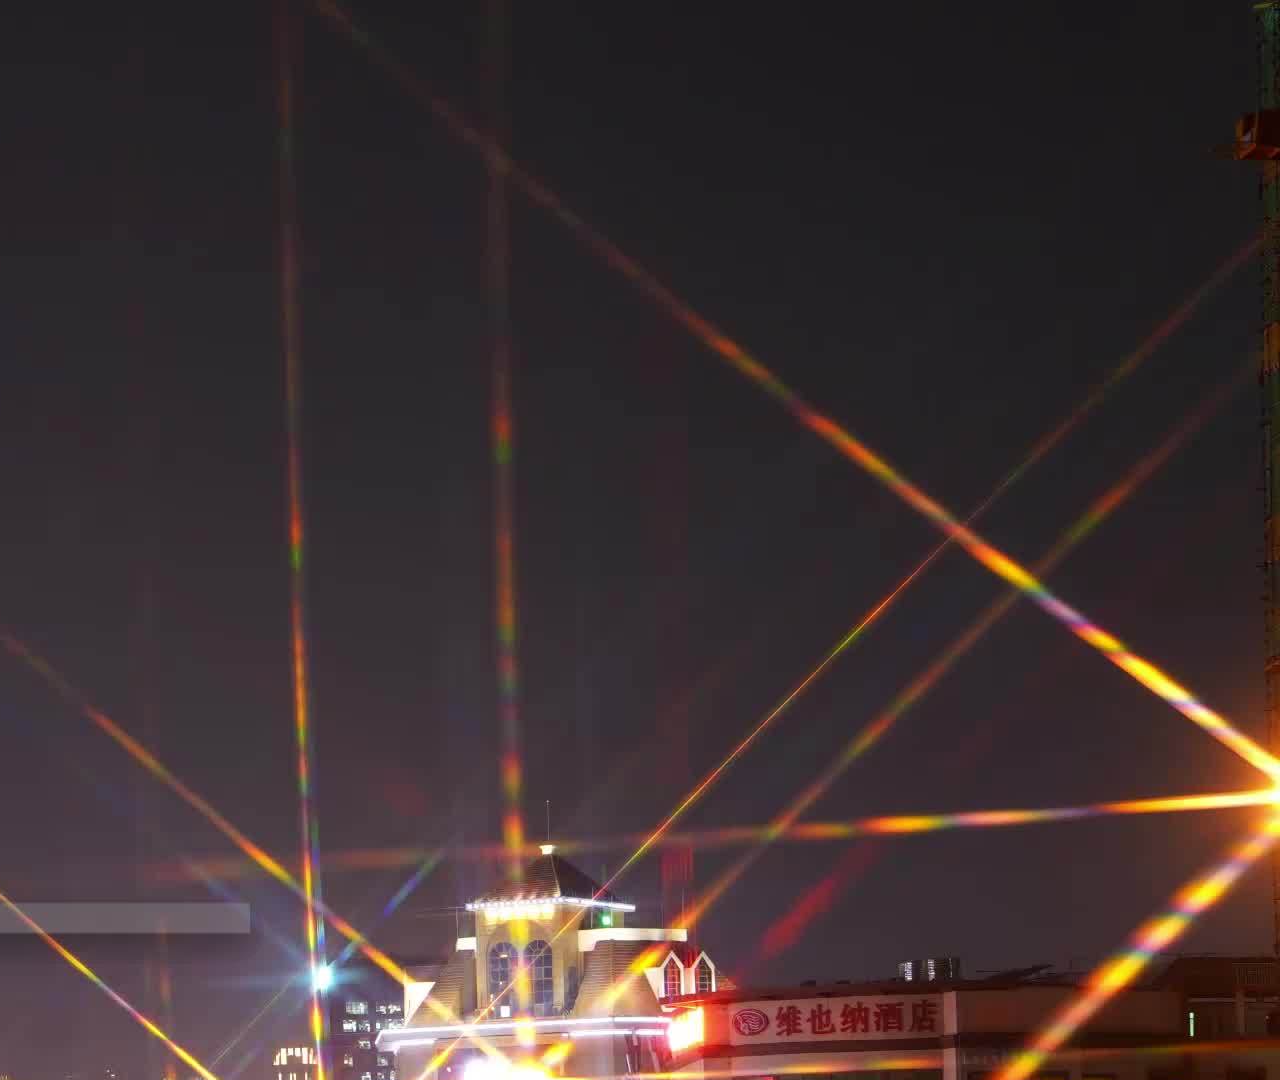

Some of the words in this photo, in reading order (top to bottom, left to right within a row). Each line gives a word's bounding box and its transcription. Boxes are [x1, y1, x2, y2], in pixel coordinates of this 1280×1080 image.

[775, 1000, 938, 1037] 维也纳酒店
